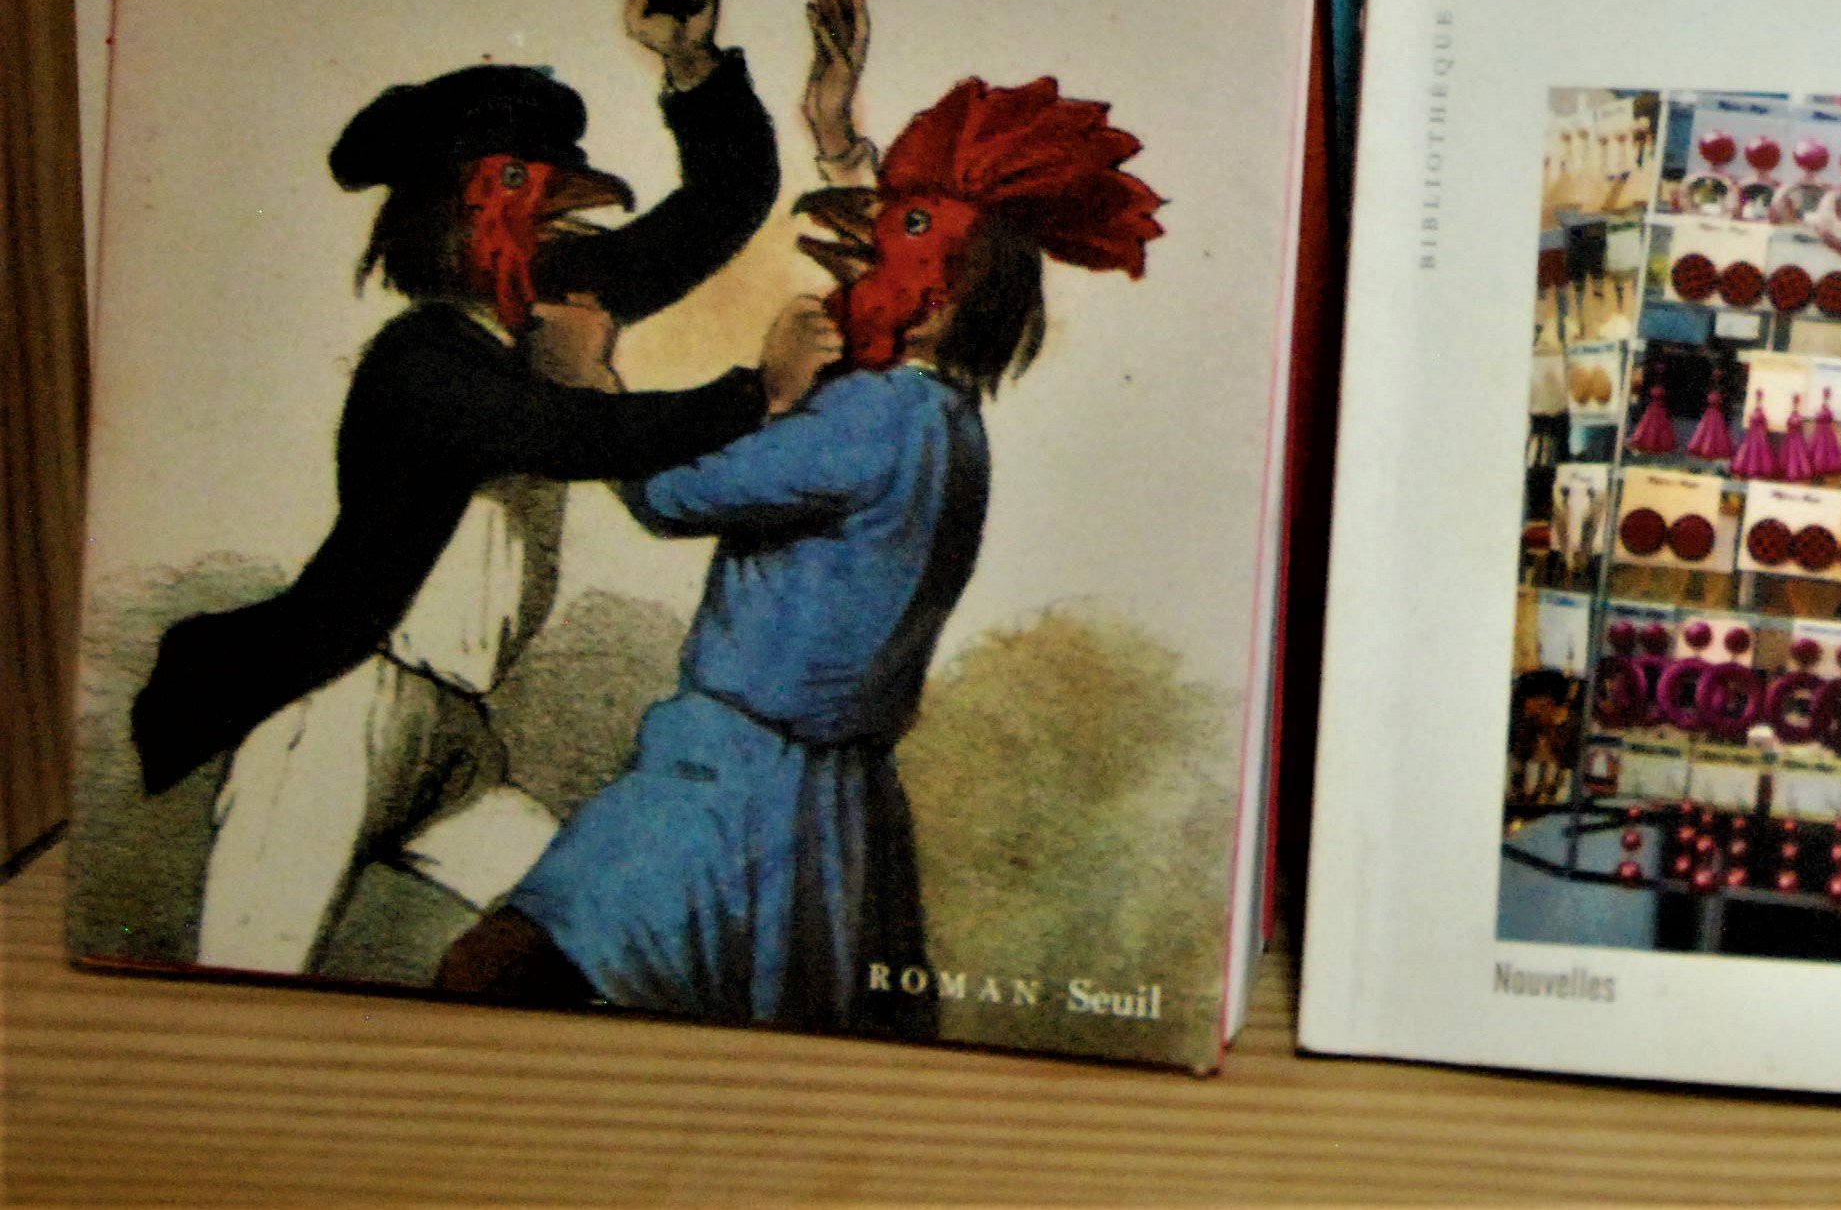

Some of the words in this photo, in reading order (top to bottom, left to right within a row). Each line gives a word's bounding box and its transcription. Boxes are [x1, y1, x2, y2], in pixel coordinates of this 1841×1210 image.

[867, 960, 1040, 1007] ROMAN
[1067, 977, 1162, 1021] Seuil
[1494, 960, 1616, 1004] Nouvelles
